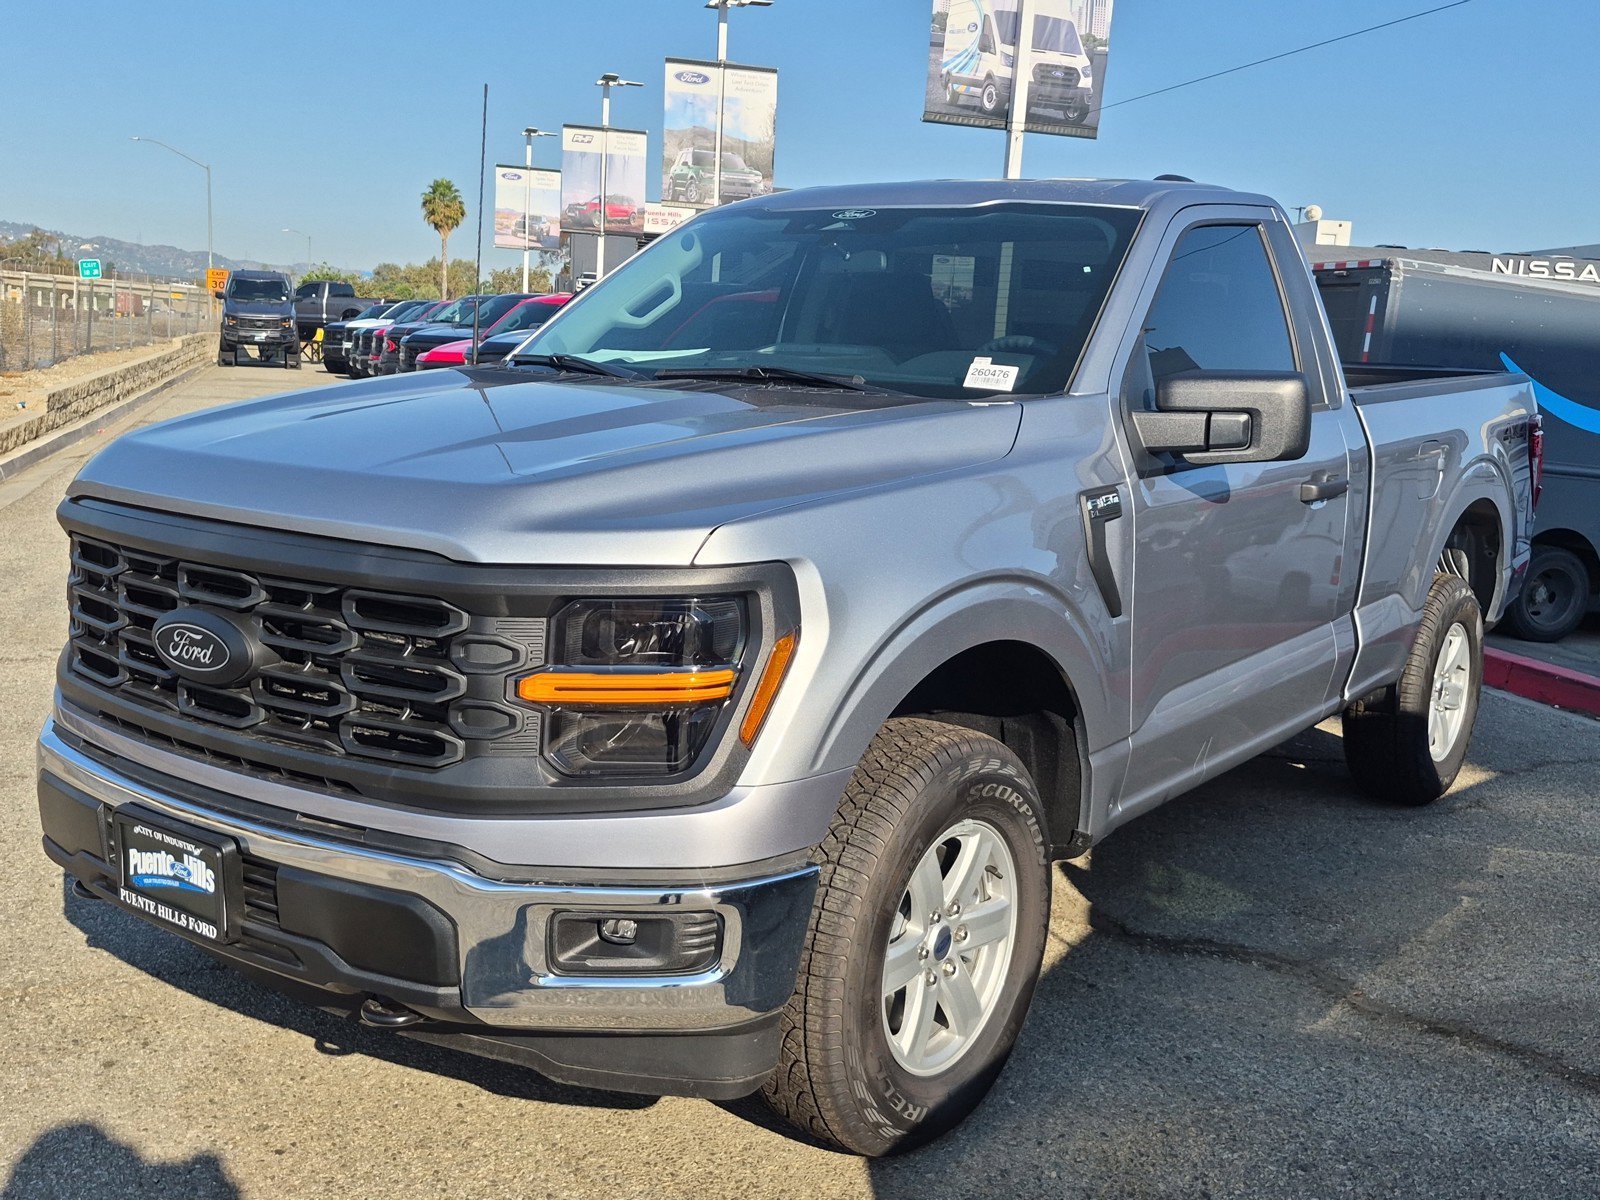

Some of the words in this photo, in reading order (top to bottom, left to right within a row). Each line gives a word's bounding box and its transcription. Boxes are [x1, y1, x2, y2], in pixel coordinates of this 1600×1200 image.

[647, 218, 683, 226] ISSA
[1491, 257, 1600, 282] NISSA
[211, 280, 225, 289] 30
[971, 367, 1010, 379] 260476
[169, 629, 214, 664] Ford
[967, 783, 1048, 866] SCORPION
[139, 826, 154, 838] CITY
[153, 831, 163, 841] OF
[163, 834, 196, 853] INDUSTRY
[129, 848, 175, 876] Puente
[183, 853, 215, 893] Hills
[173, 864, 189, 877] Ford
[120, 888, 157, 915] PUENTE
[157, 904, 187, 928] HILLS
[188, 916, 218, 939] FORD
